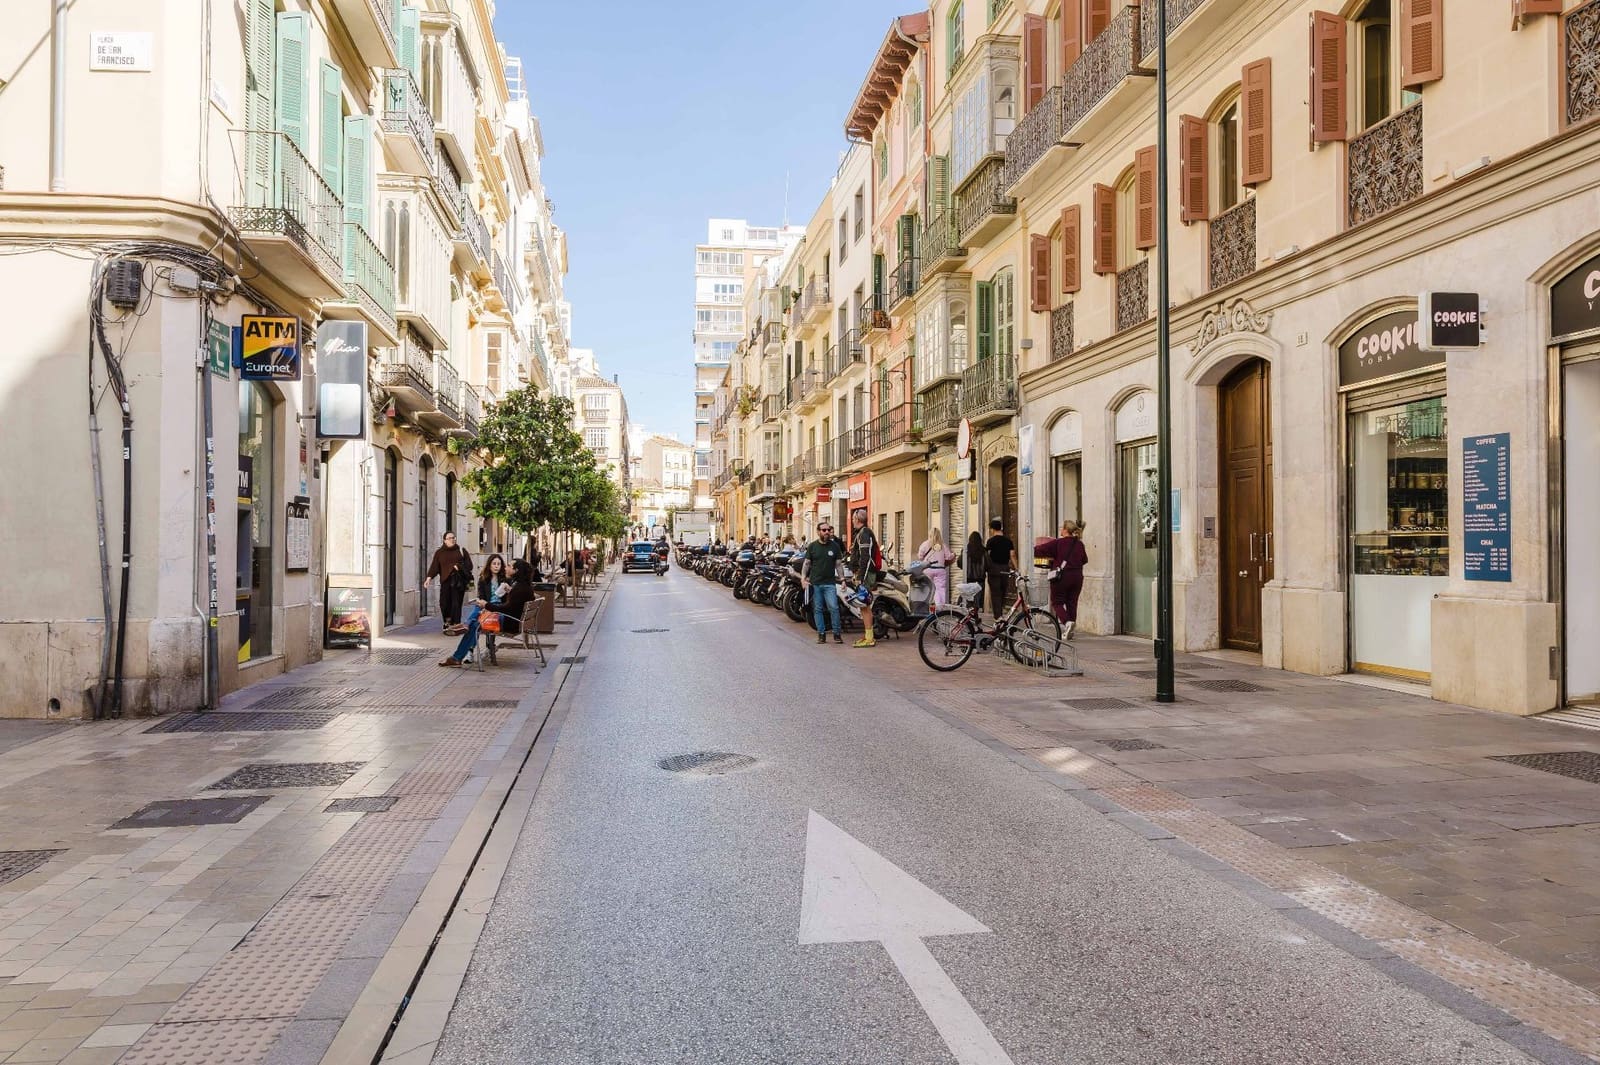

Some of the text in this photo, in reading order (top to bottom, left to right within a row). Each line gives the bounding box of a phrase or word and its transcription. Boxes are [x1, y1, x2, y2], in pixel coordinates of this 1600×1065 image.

[97, 45, 121, 54] DE SAN
[97, 55, 135, 64] FRANCISCO
[1434, 311, 1477, 325] COOKIE
[246, 321, 295, 338] ATM
[1360, 352, 1392, 367] YORK
[245, 362, 290, 373] Euronet
[238, 470, 249, 488] TM
